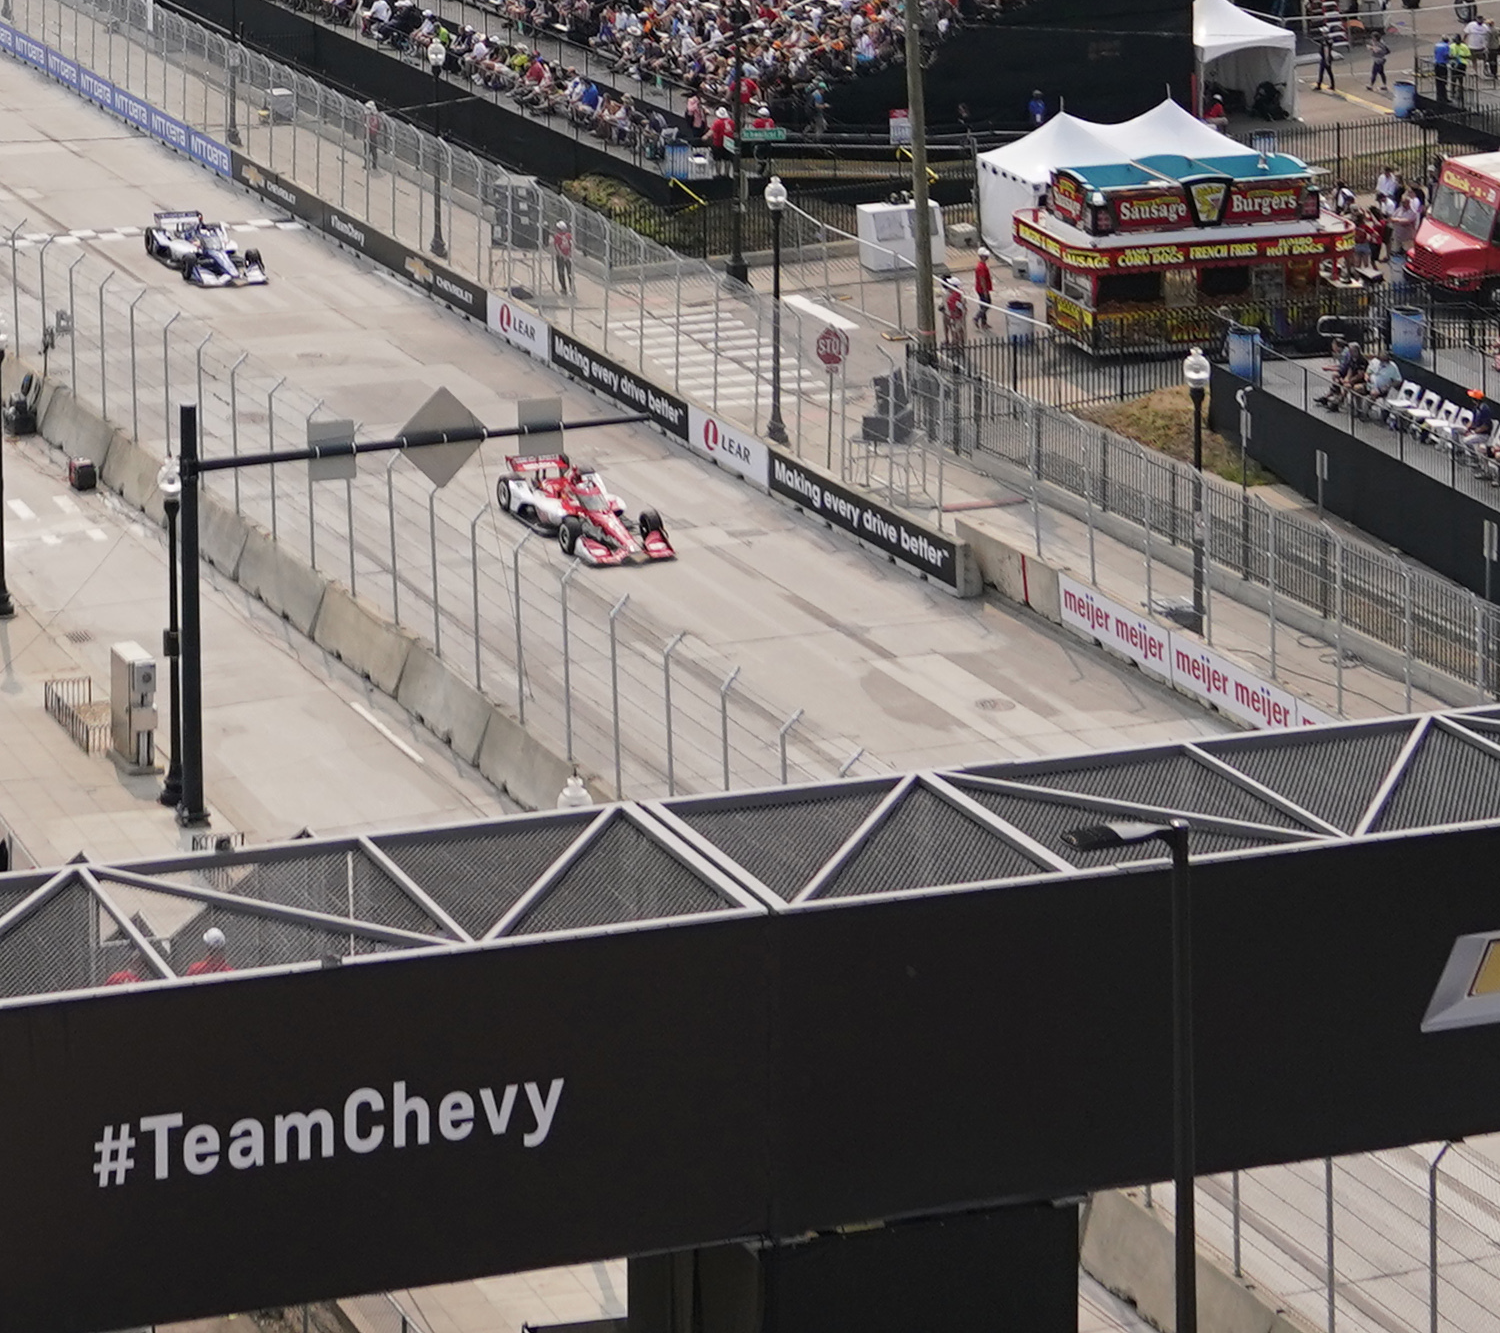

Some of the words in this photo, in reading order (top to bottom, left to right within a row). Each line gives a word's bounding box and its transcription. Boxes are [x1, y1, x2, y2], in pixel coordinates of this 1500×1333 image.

[1120, 202, 1187, 222] Sausage
[1232, 192, 1297, 214] Burgers
[1062, 251, 1110, 270] SAUSAGE
[1117, 254, 1150, 267] CORN
[1152, 252, 1185, 265] DOGS
[1189, 245, 1228, 260] FRENCH
[1230, 242, 1258, 256] FRIES
[1266, 245, 1291, 257] HOT
[1293, 242, 1324, 254] DOGS
[513, 318, 536, 342] LEAR
[554, 335, 590, 380] Making
[591, 360, 619, 397] every
[620, 374, 647, 409] drive
[721, 436, 751, 465] LEAR
[774, 459, 822, 508] Making
[823, 485, 861, 527] every
[862, 506, 898, 545] drive
[1063, 586, 1113, 633] meijer
[1115, 615, 1165, 667] meijer
[1176, 639, 1229, 698] meijer
[1235, 673, 1291, 731] meijer
[93, 1078, 564, 1187] #TeamChevy
